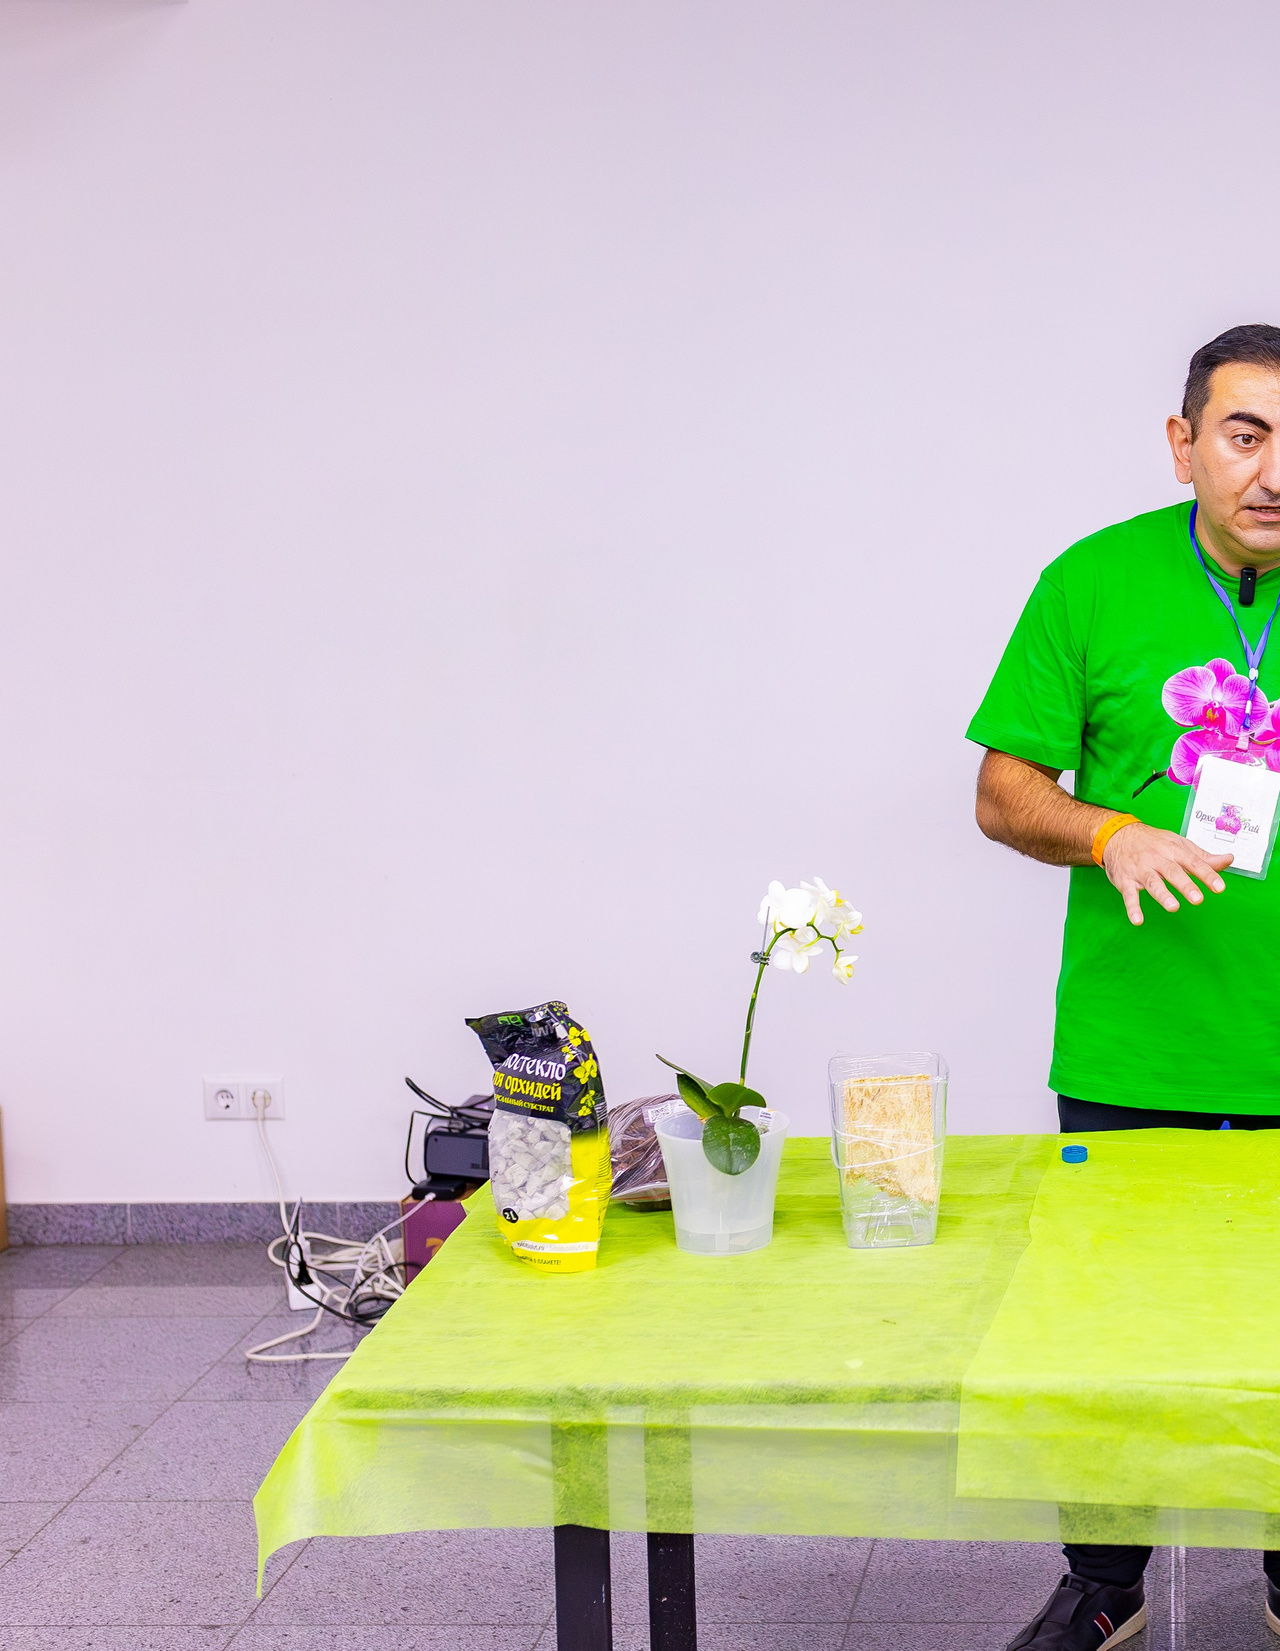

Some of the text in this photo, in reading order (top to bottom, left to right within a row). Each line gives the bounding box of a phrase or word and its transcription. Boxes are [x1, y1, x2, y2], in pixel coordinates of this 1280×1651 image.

[493, 1071, 562, 1101] ля орхидей
[523, 1101, 555, 1113] СУБСТРАТ
